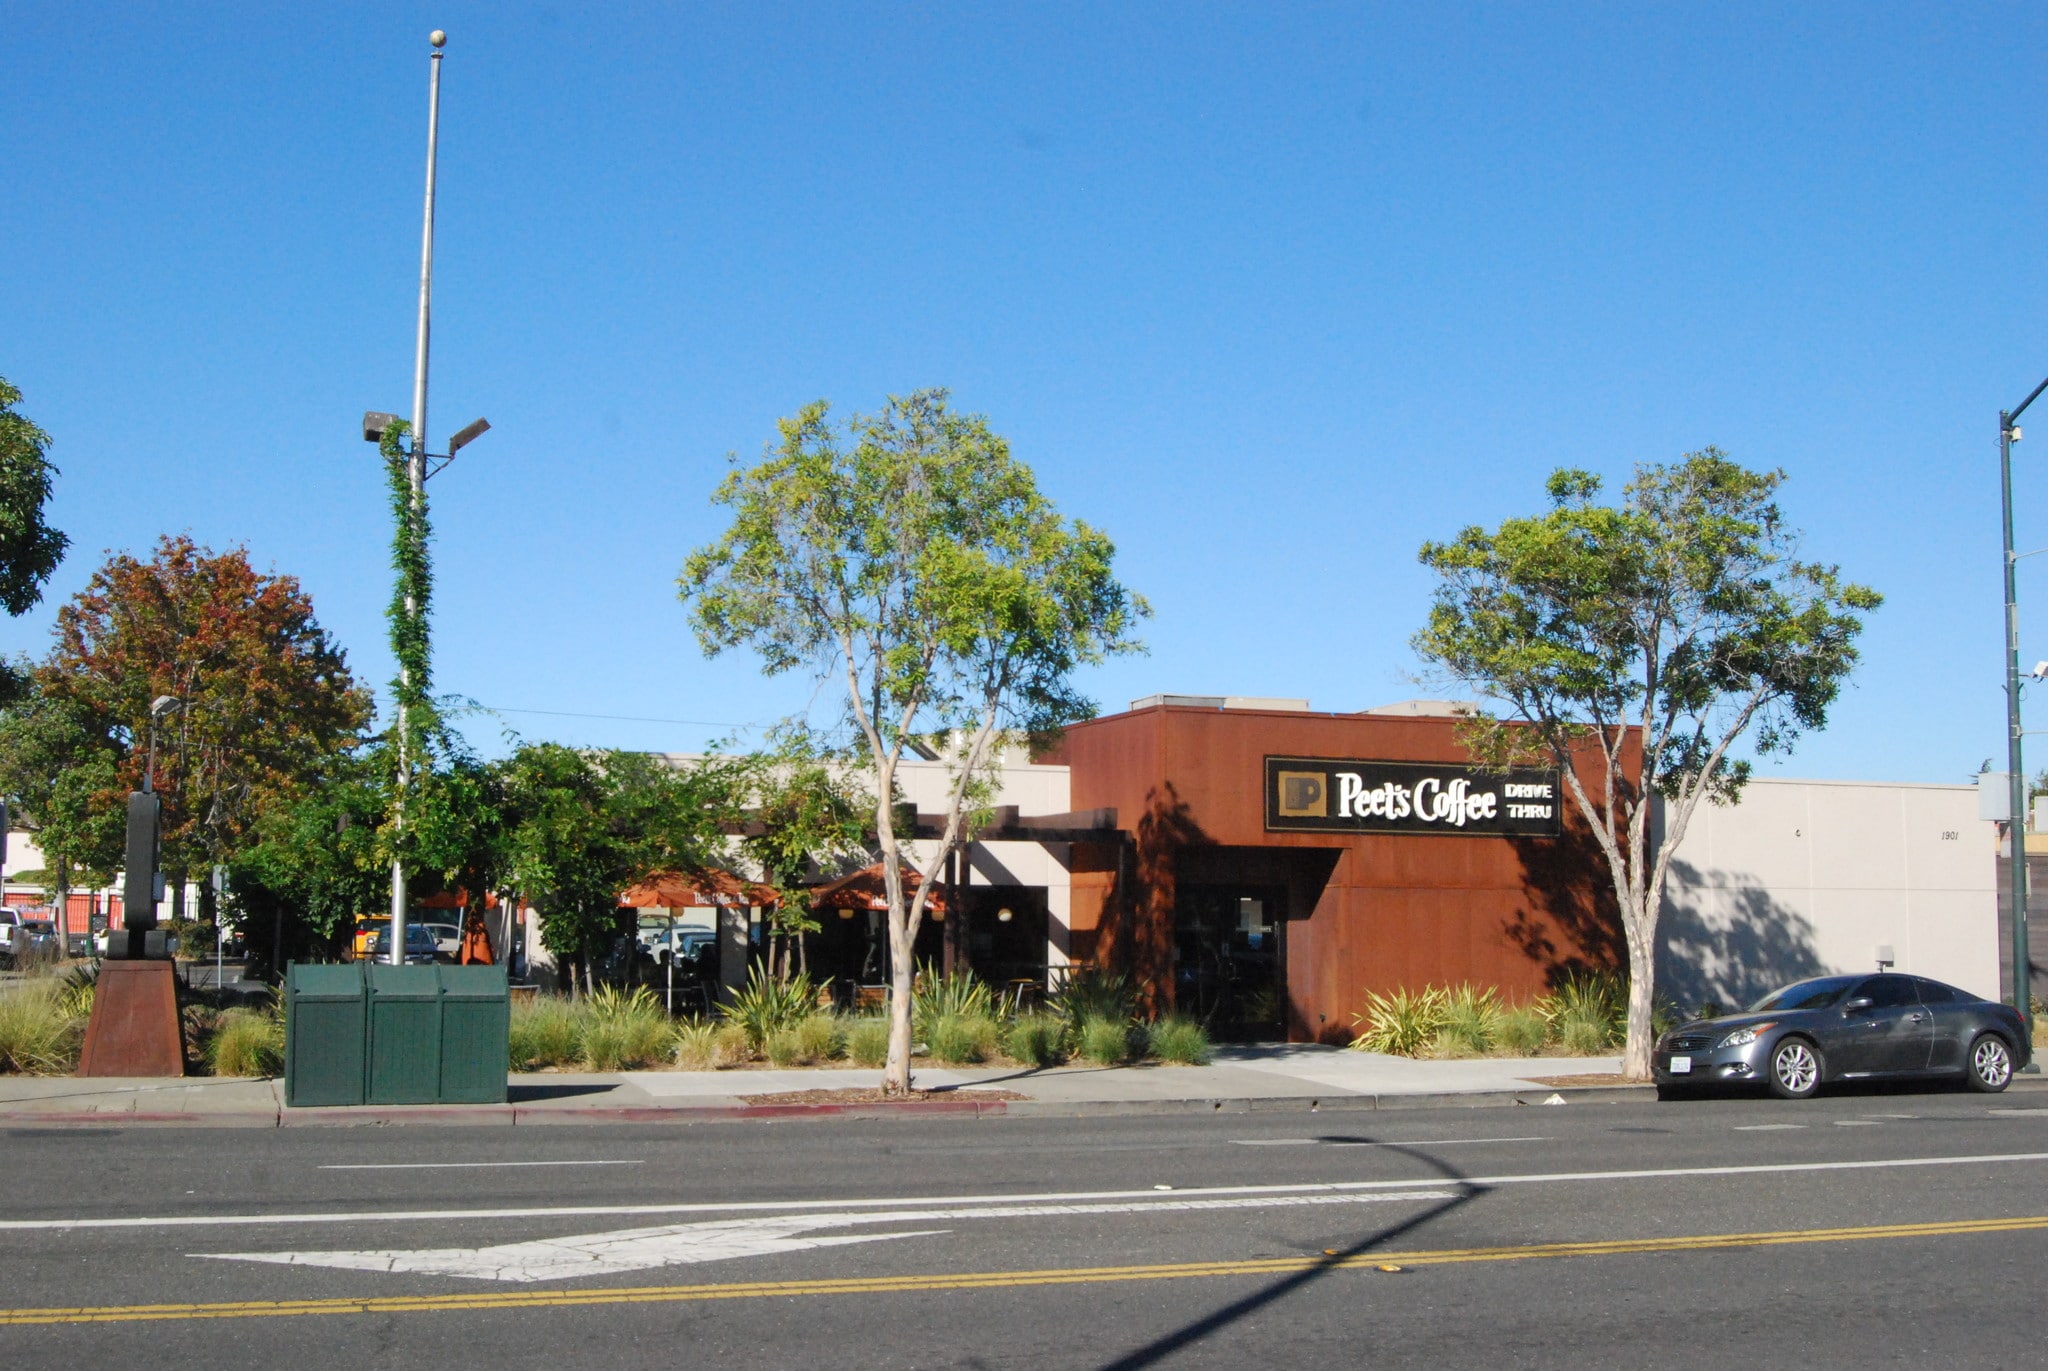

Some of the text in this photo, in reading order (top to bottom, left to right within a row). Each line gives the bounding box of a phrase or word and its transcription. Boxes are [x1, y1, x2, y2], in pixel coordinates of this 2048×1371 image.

[1504, 783, 1553, 798] DRIVE
[1335, 773, 1497, 826] Peet's Coffee
[1506, 804, 1552, 819] THRU
[1941, 831, 1959, 841] 1901
